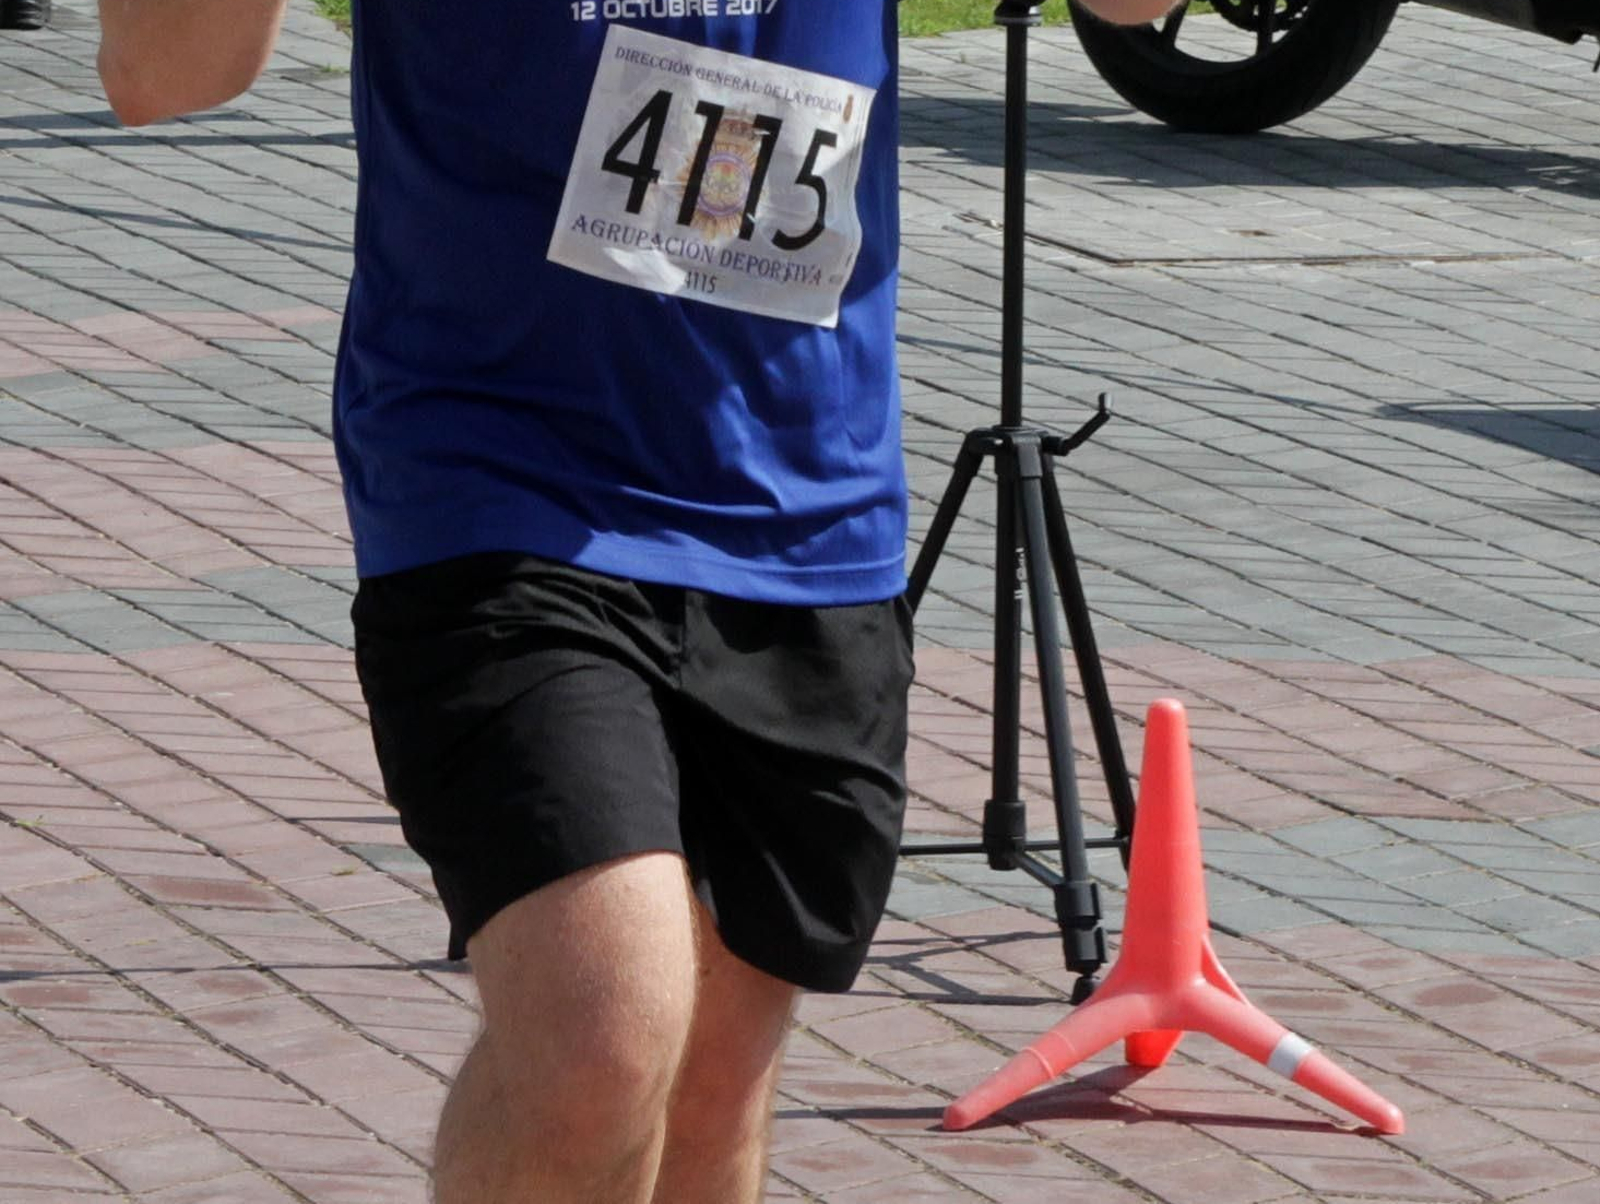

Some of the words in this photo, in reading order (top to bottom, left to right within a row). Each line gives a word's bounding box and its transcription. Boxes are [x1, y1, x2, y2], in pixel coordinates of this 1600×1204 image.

[570, 0, 596, 21] 12
[694, 66, 761, 94] GENERAL
[762, 82, 782, 99] DE
[784, 88, 802, 104] LA
[600, 88, 838, 252] 4115
[718, 248, 823, 287] DEPORTIVA
